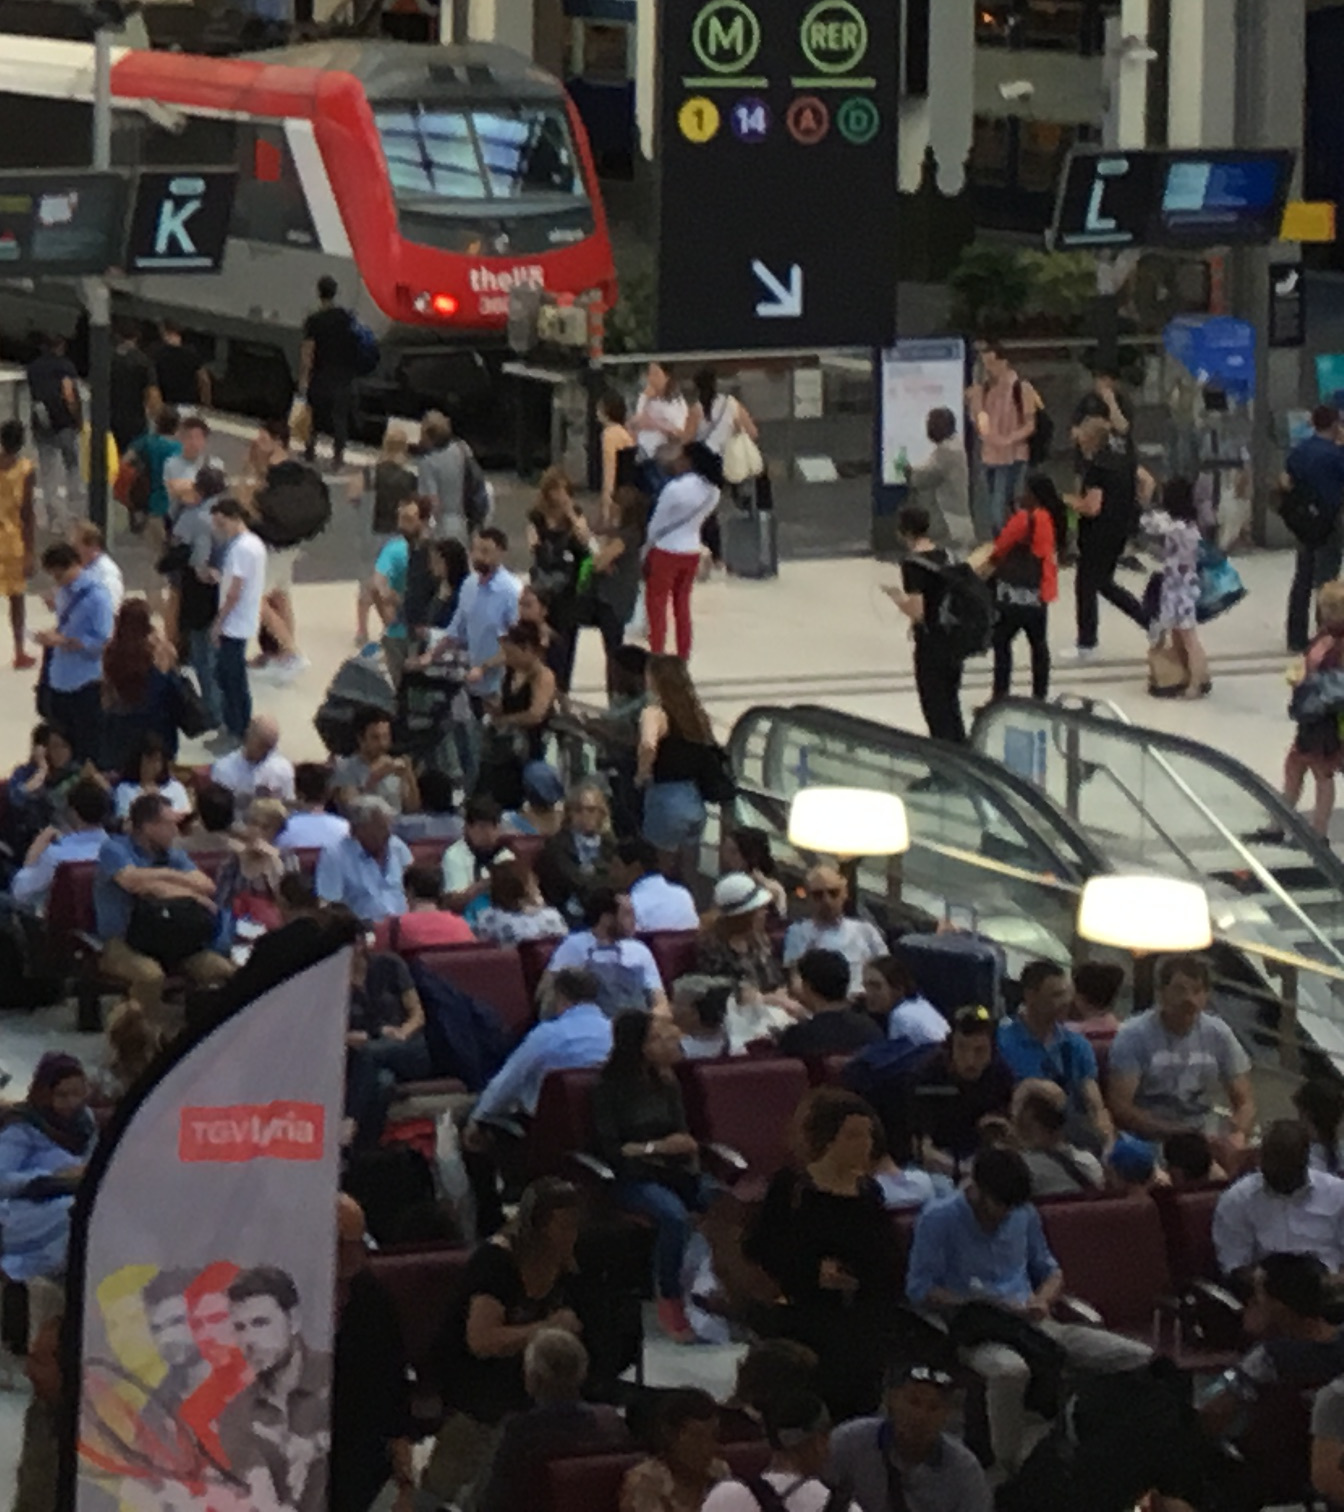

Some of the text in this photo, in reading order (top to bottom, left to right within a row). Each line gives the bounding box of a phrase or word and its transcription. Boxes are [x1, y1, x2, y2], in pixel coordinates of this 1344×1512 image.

[707, 15, 859, 56] M RER
[734, 106, 767, 134] 14
[1084, 177, 1117, 231] L
[154, 198, 202, 255] K
[191, 1119, 249, 1145] TGV
